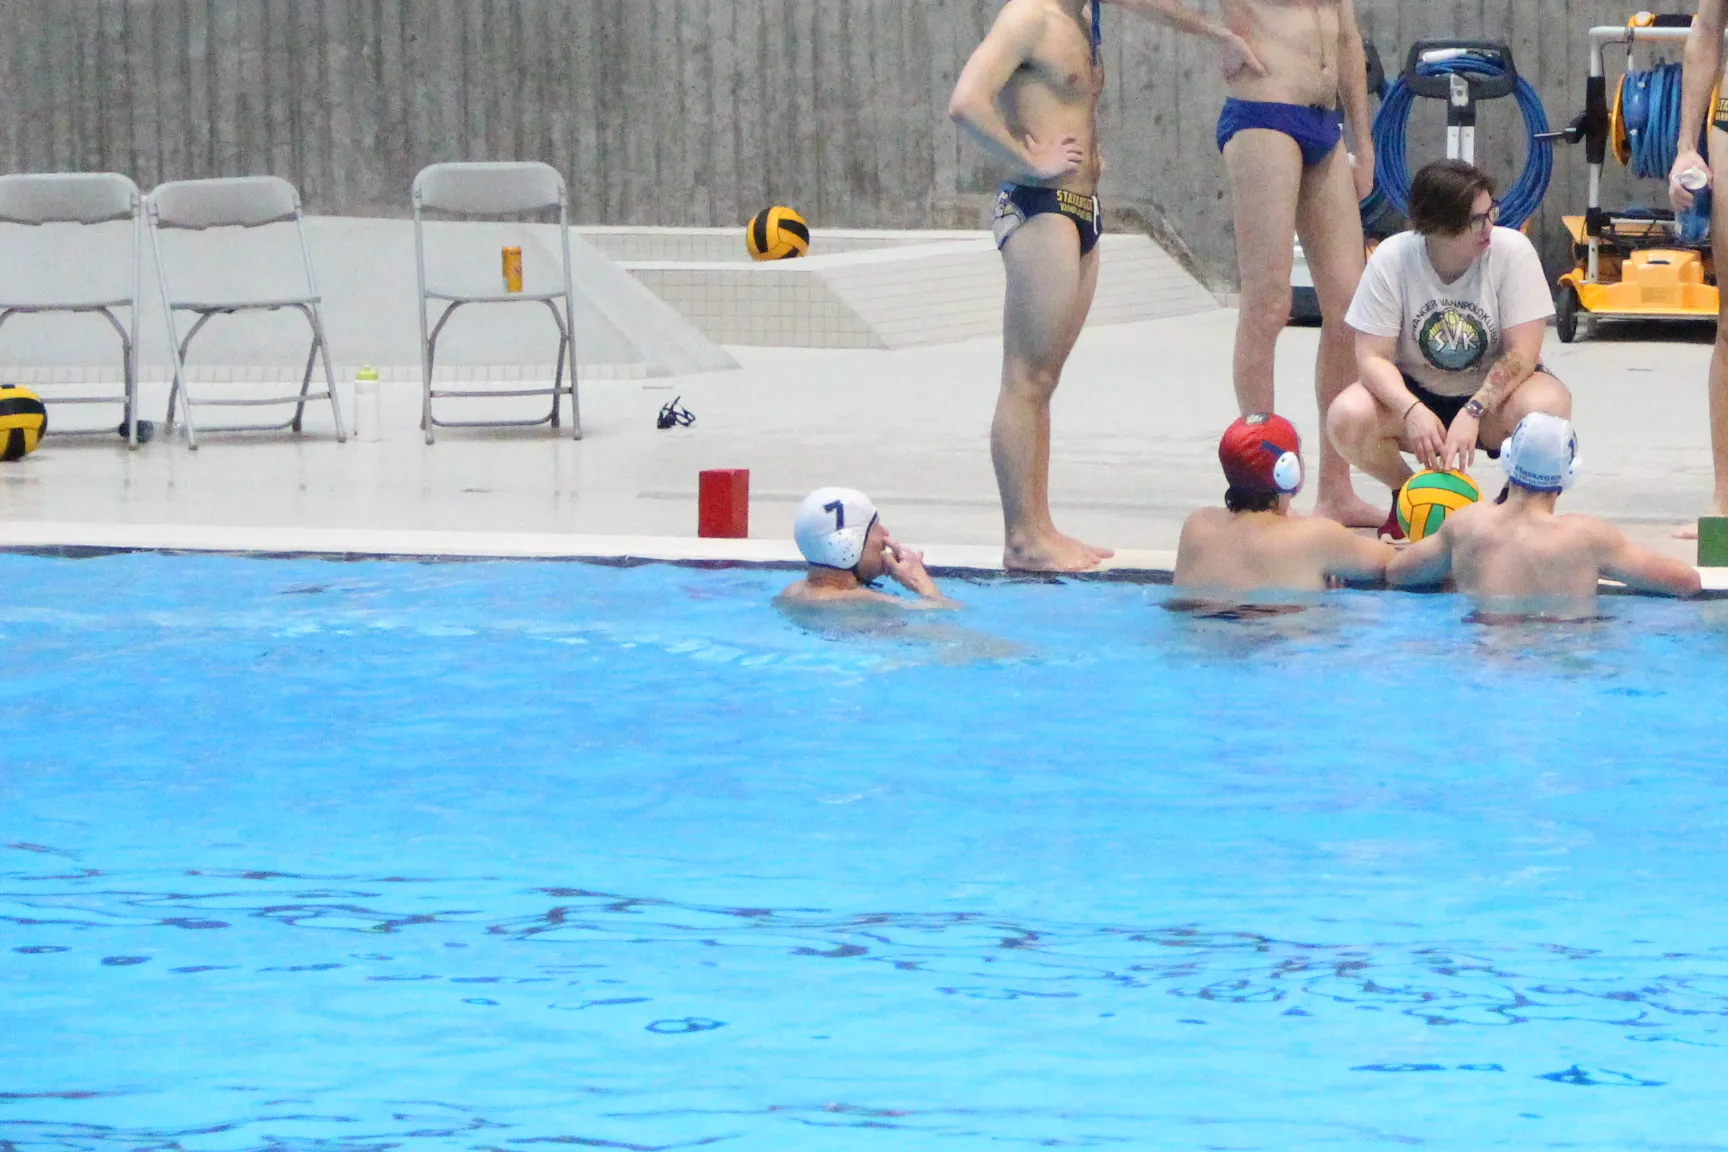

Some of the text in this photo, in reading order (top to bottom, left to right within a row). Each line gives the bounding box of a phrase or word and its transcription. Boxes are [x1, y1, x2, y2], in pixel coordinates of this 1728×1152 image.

[1411, 299, 1438, 344] VANGER
[1434, 320, 1477, 352] SVK
[823, 499, 844, 531] 7
